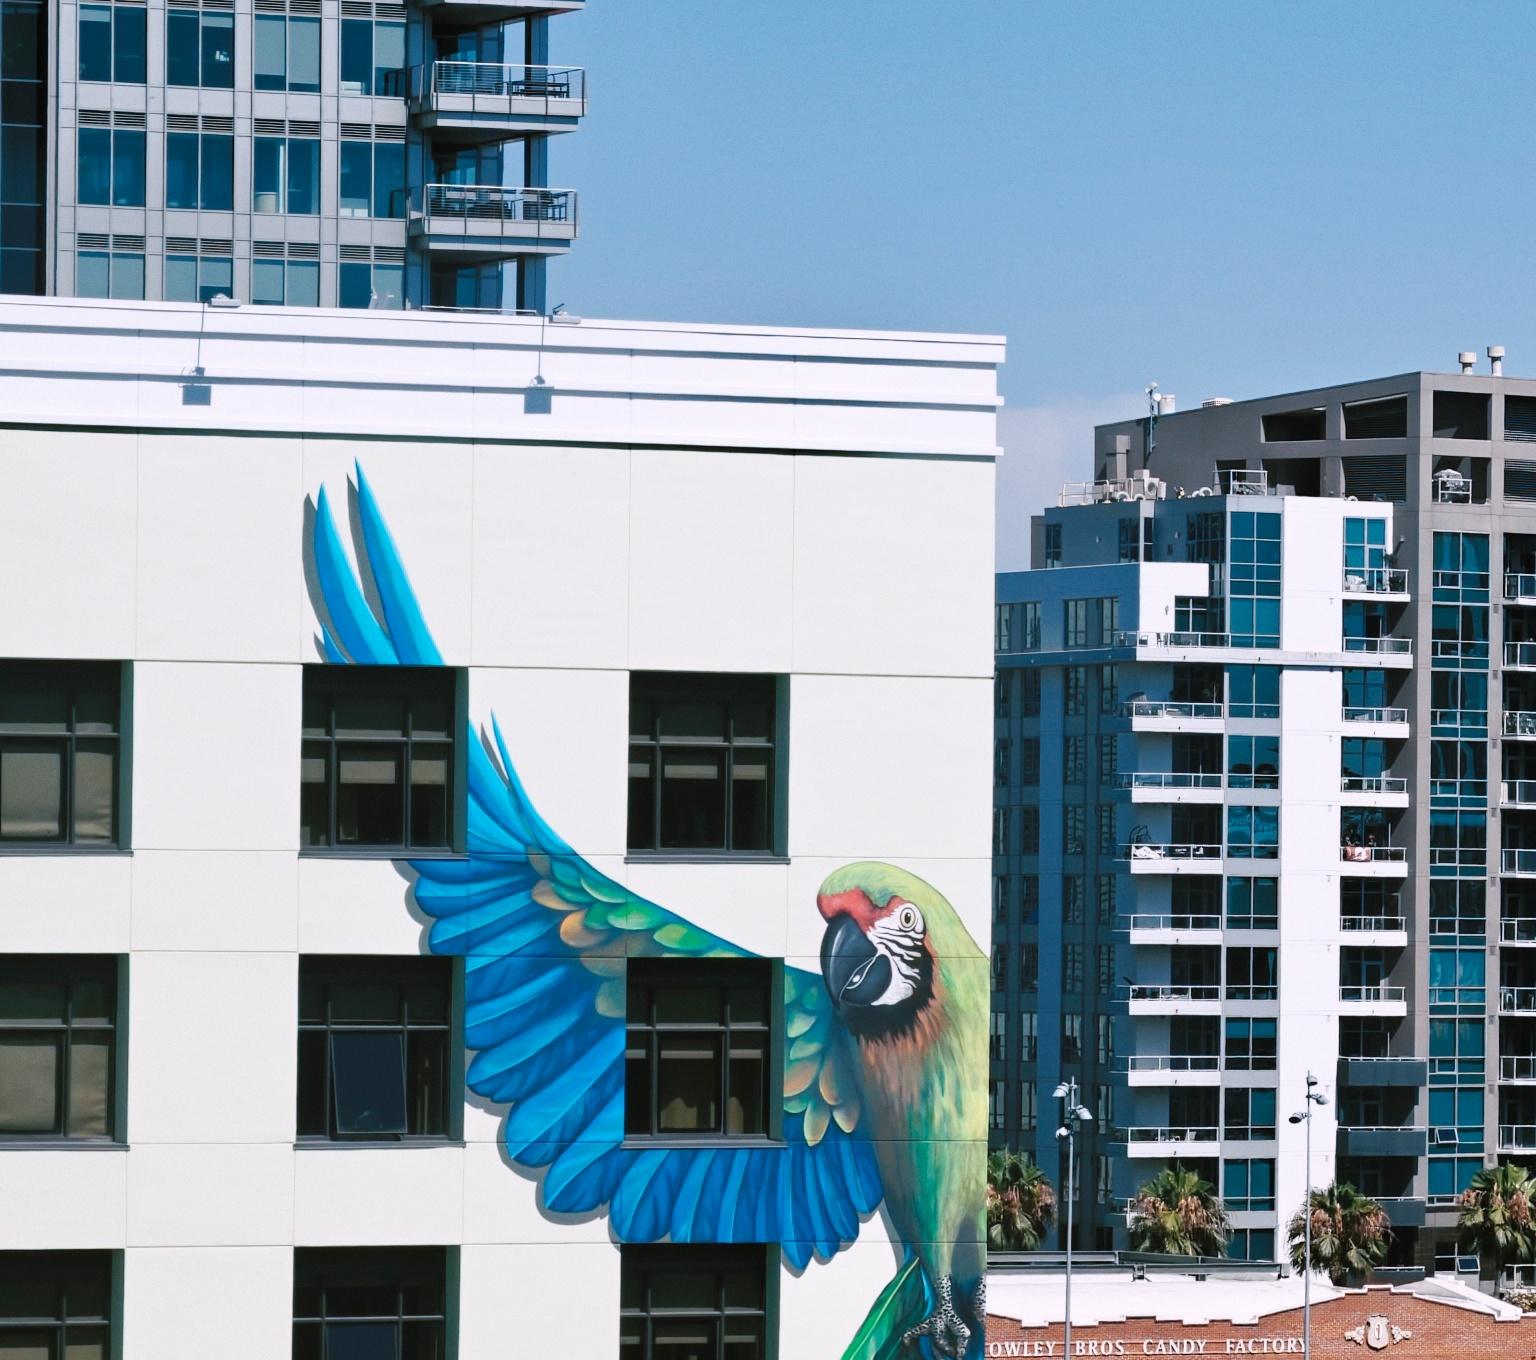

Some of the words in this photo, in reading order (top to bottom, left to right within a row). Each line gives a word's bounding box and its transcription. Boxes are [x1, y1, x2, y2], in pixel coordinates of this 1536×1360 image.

[1075, 1339, 1130, 1356] BROS.
[1142, 1339, 1207, 1355] CANDY
[1226, 1337, 1306, 1354] FACTORY
